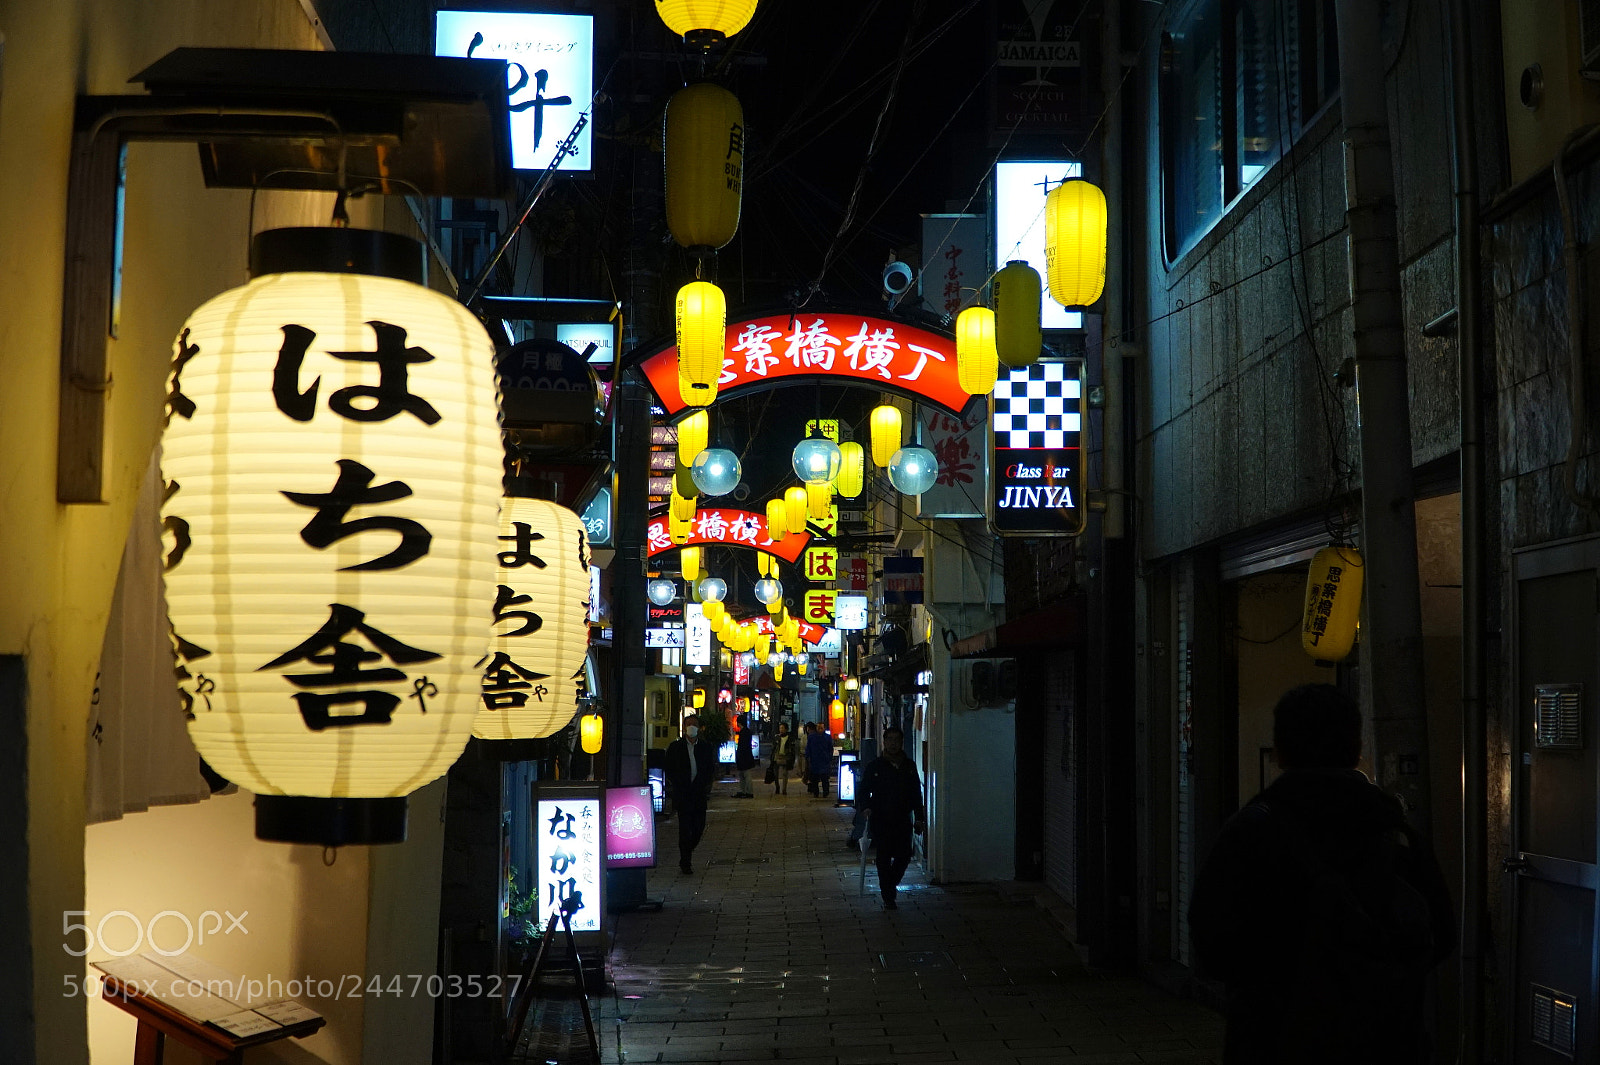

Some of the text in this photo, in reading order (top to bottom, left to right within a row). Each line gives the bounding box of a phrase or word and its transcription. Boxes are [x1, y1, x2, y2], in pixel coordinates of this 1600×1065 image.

[999, 45, 1078, 61] JAMAICA
[1005, 463, 1070, 479] Glass Bar
[999, 486, 1075, 509] JINYA
[256, 318, 443, 732] はち舎
